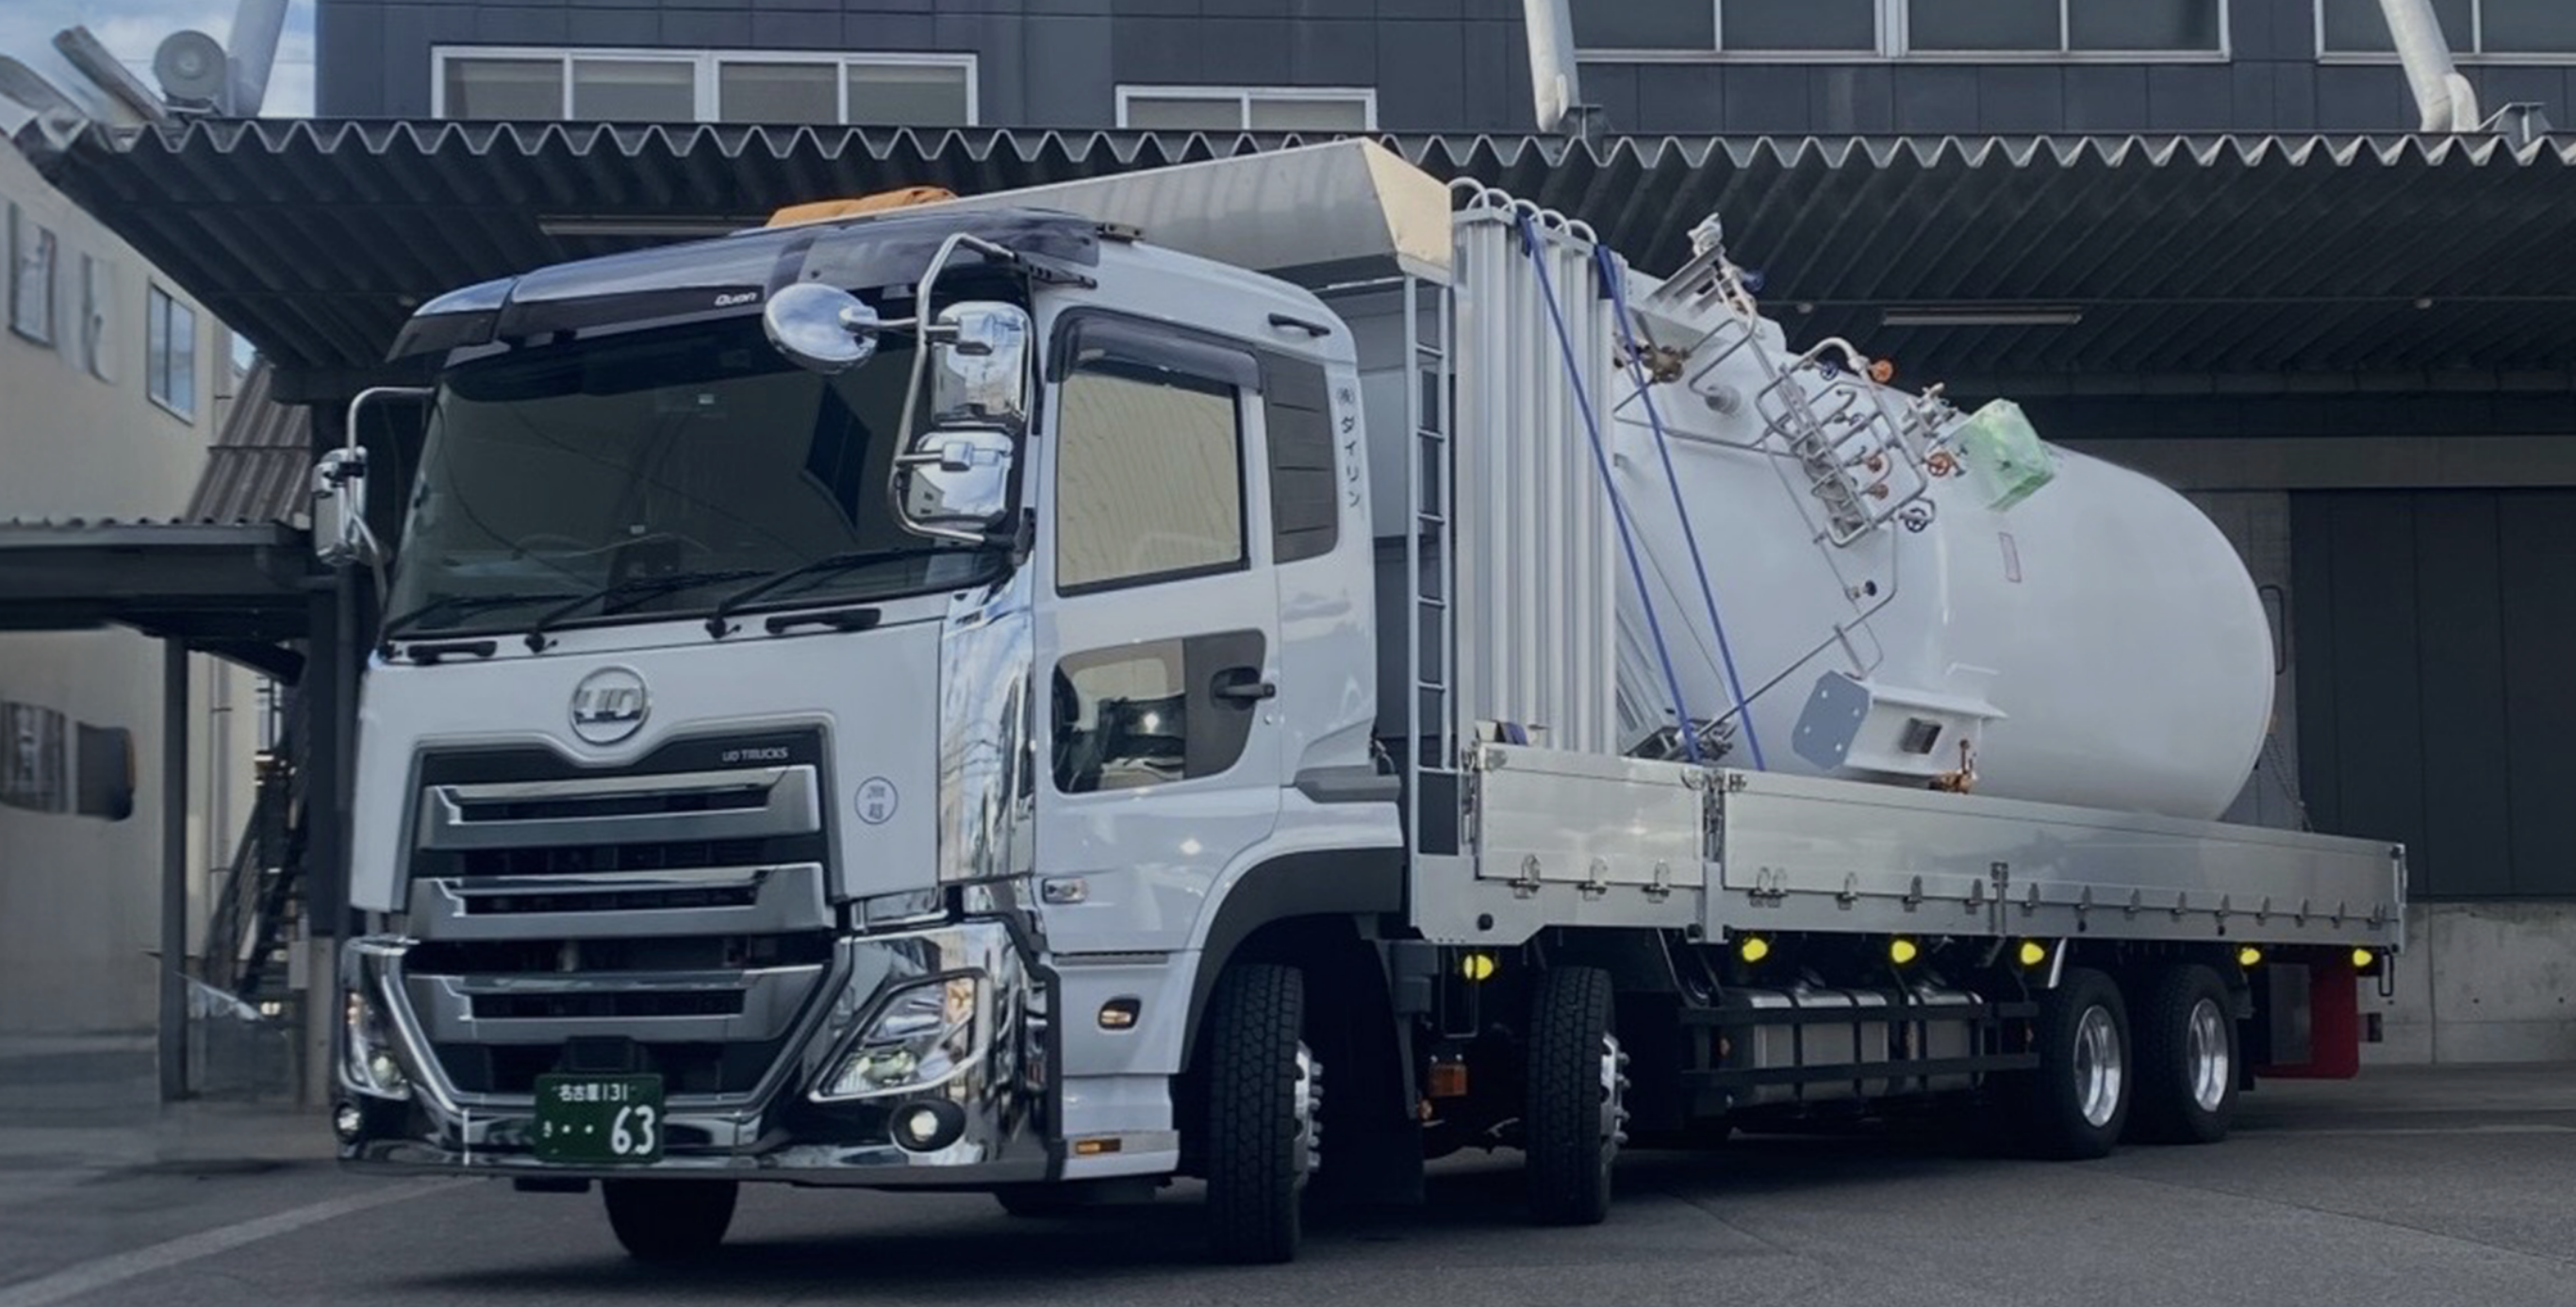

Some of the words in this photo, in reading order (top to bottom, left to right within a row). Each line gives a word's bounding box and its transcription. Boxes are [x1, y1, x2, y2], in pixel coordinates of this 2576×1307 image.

[715, 292, 757, 306] Quon
[573, 687, 646, 724] UD
[722, 751, 739, 762] UD
[741, 747, 788, 761] TRUCKS
[611, 1103, 655, 1155] 63
